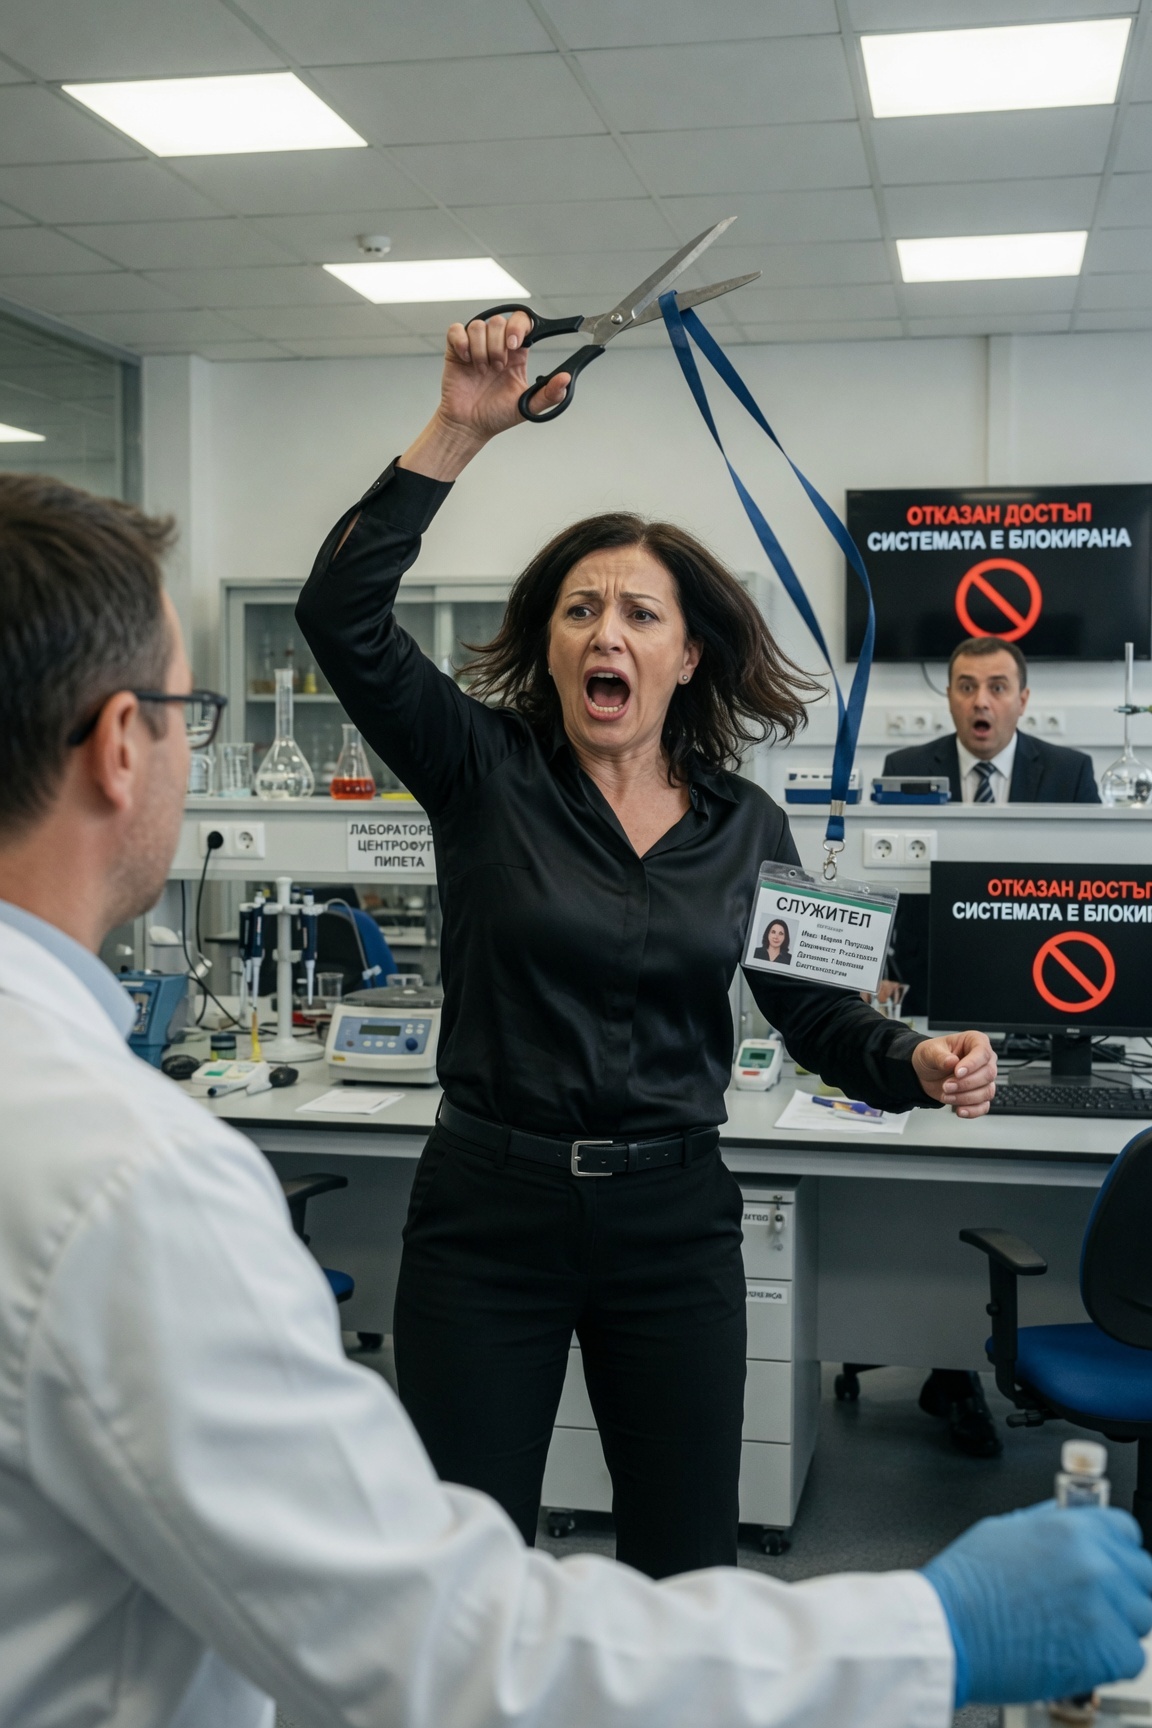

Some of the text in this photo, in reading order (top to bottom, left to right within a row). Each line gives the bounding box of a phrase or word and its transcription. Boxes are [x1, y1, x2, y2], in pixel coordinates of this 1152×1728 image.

[907, 502, 1092, 527] ОТКАЗАН ДОСТЪП
[867, 528, 1132, 551] СИСТЕМАТА Е БЛОКИРАНА
[374, 856, 425, 867] ПИПЕТА
[987, 879, 1074, 897] ОТКАЗАН
[776, 897, 871, 928] СЛУЖИТЕЛ
[952, 902, 1063, 921] СИСТЕМАТА
[1067, 904, 1079, 921] Е
